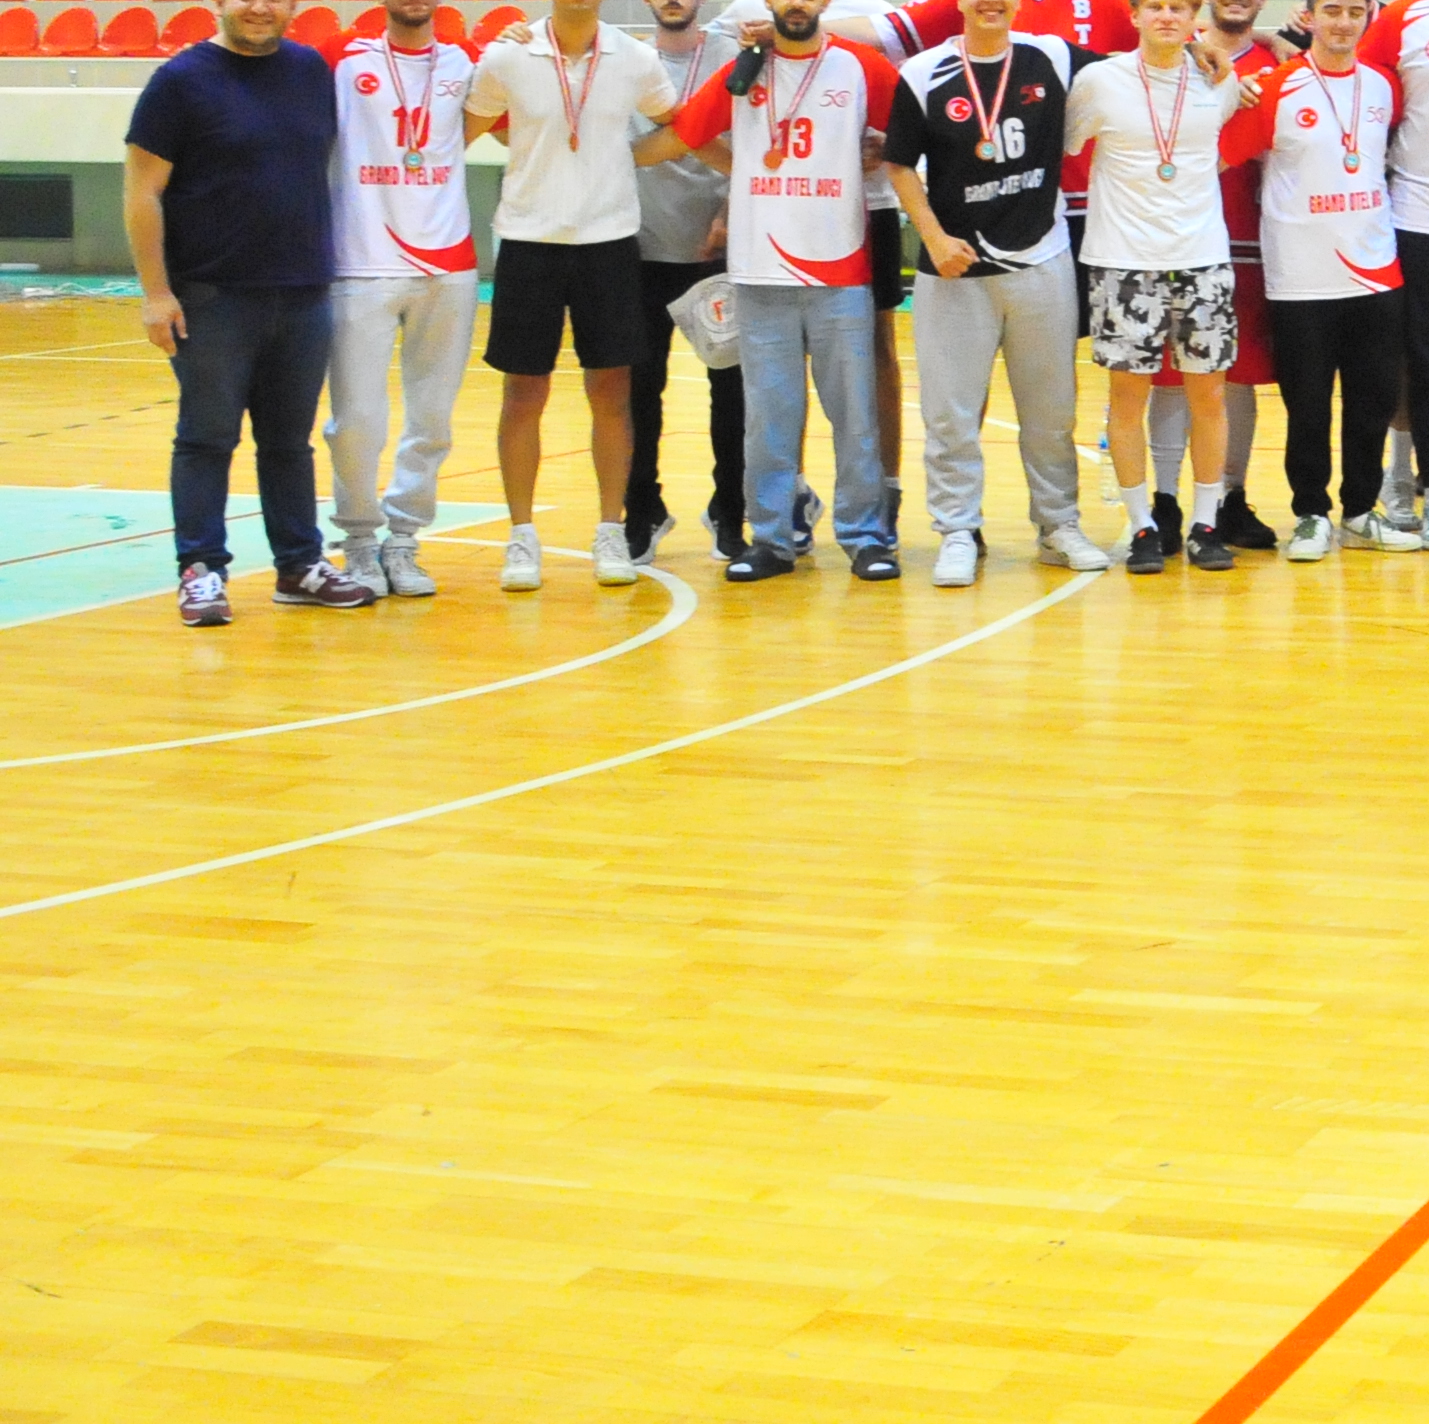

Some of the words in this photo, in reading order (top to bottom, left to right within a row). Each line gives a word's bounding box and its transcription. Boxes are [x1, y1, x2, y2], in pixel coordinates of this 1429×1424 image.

[393, 106, 430, 149] 10
[778, 117, 813, 159] 13
[991, 117, 1026, 163] 16
[360, 166, 399, 185] GRAND
[786, 177, 812, 196] OTEL
[1309, 193, 1345, 214] GRAND
[1350, 191, 1371, 211] OTEL
